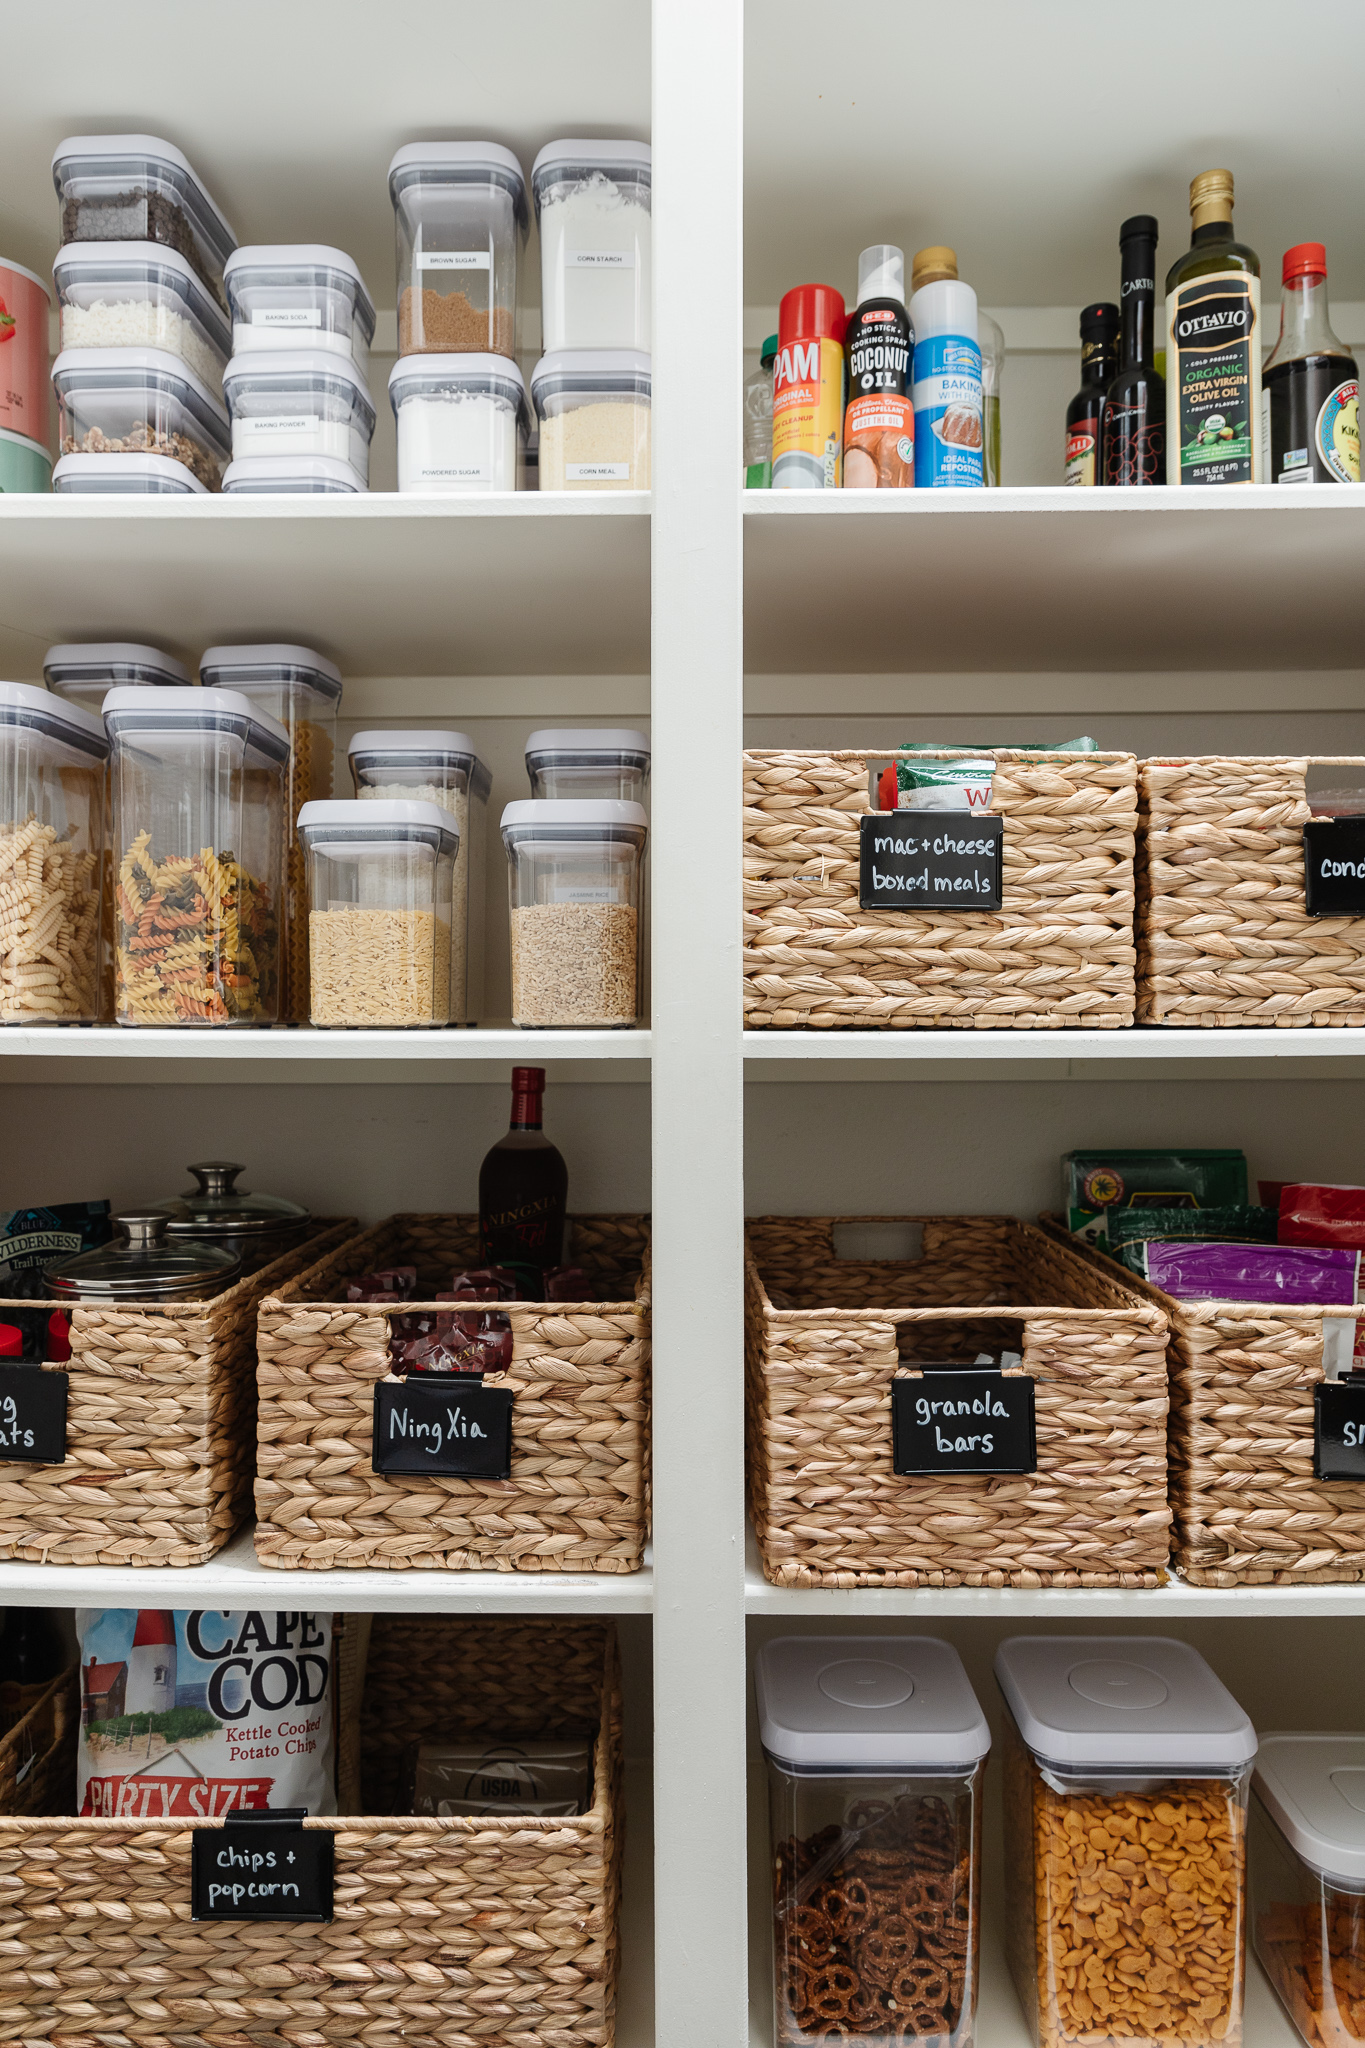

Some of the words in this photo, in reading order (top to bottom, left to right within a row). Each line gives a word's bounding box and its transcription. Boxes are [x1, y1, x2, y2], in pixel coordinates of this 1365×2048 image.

[861, 326, 873, 335] NO
[874, 324, 897, 333] STICK
[1178, 310, 1247, 337] OTTAVIO
[851, 336, 884, 351] COOKING
[885, 336, 907, 347] SPRAY
[773, 342, 819, 390] PAM
[850, 346, 909, 377] COCONUT
[1190, 359, 1208, 367] COLD
[1209, 354, 1238, 364] PRESSED
[861, 371, 897, 389] OIL
[1185, 363, 1243, 382] ORGANIC
[942, 380, 981, 396] BAKING
[1182, 380, 1213, 395] EXTRA
[1213, 375, 1248, 388] VIRGIN
[939, 391, 962, 400] WITH
[1190, 389, 1220, 404] OLIVE
[1221, 387, 1240, 398] OIL
[852, 410, 861, 418] OR
[862, 405, 905, 415] PROPELLANT
[1191, 404, 1213, 413] FRUITY
[1215, 400, 1239, 408] FLAVOR
[781, 415, 813, 427] CLEANUP
[855, 417, 871, 428] JUST
[873, 416, 885, 424] THE
[889, 416, 899, 425] OIL
[943, 455, 967, 463] IDEAL
[932, 770, 992, 780] Centra
[872, 865, 928, 891] boxed
[934, 869, 991, 893] meals
[489, 1194, 559, 1226] NINGXIA
[20, 1219, 46, 1231] BLUE
[12, 1255, 34, 1270] Trail
[0, 1396, 17, 1423] g
[915, 1390, 1010, 1425] granola
[935, 1426, 994, 1453] bars
[187, 1610, 325, 1660] CAPE
[208, 1654, 328, 1721] COD
[226, 1725, 272, 1742] Kettle
[278, 1716, 321, 1737] Cooked
[229, 1744, 279, 1761] Potato
[285, 1738, 316, 1755] Chips
[481, 1779, 521, 1797] USDA
[90, 1780, 182, 1817] PARTY
[188, 1783, 259, 1817] SIZE
[217, 1846, 277, 1873] chips
[208, 1882, 300, 1908] popcorn
